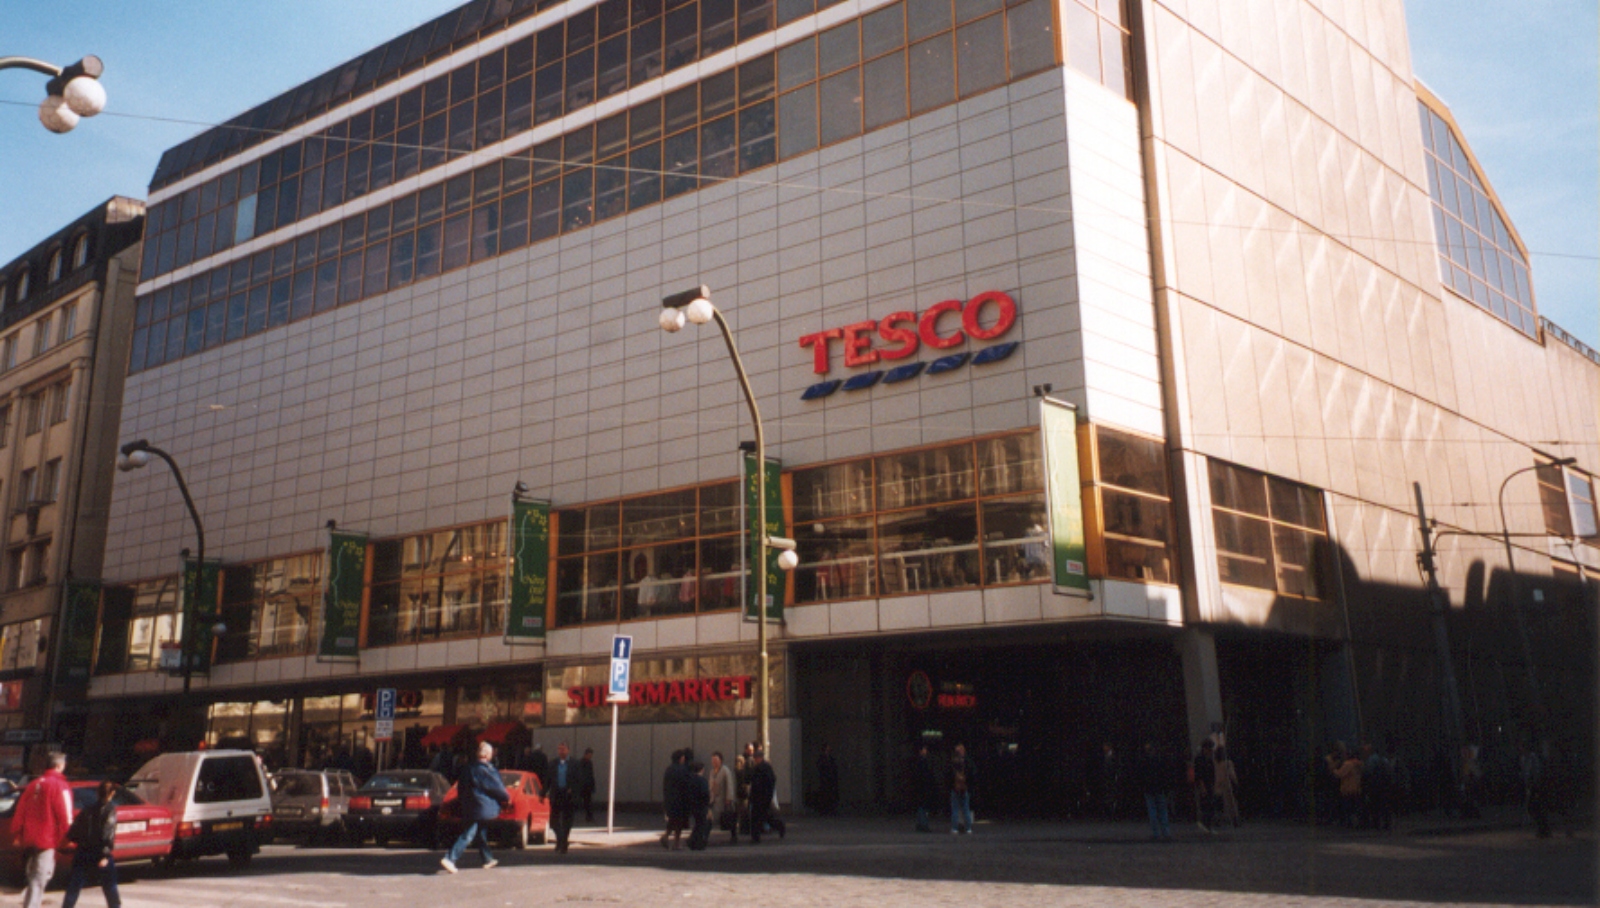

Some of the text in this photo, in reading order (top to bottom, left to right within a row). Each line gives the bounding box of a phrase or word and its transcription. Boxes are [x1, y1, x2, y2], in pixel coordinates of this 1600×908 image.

[799, 290, 1018, 374] TESCO
[613, 662, 625, 682] P
[567, 676, 752, 708] SURMARKET
